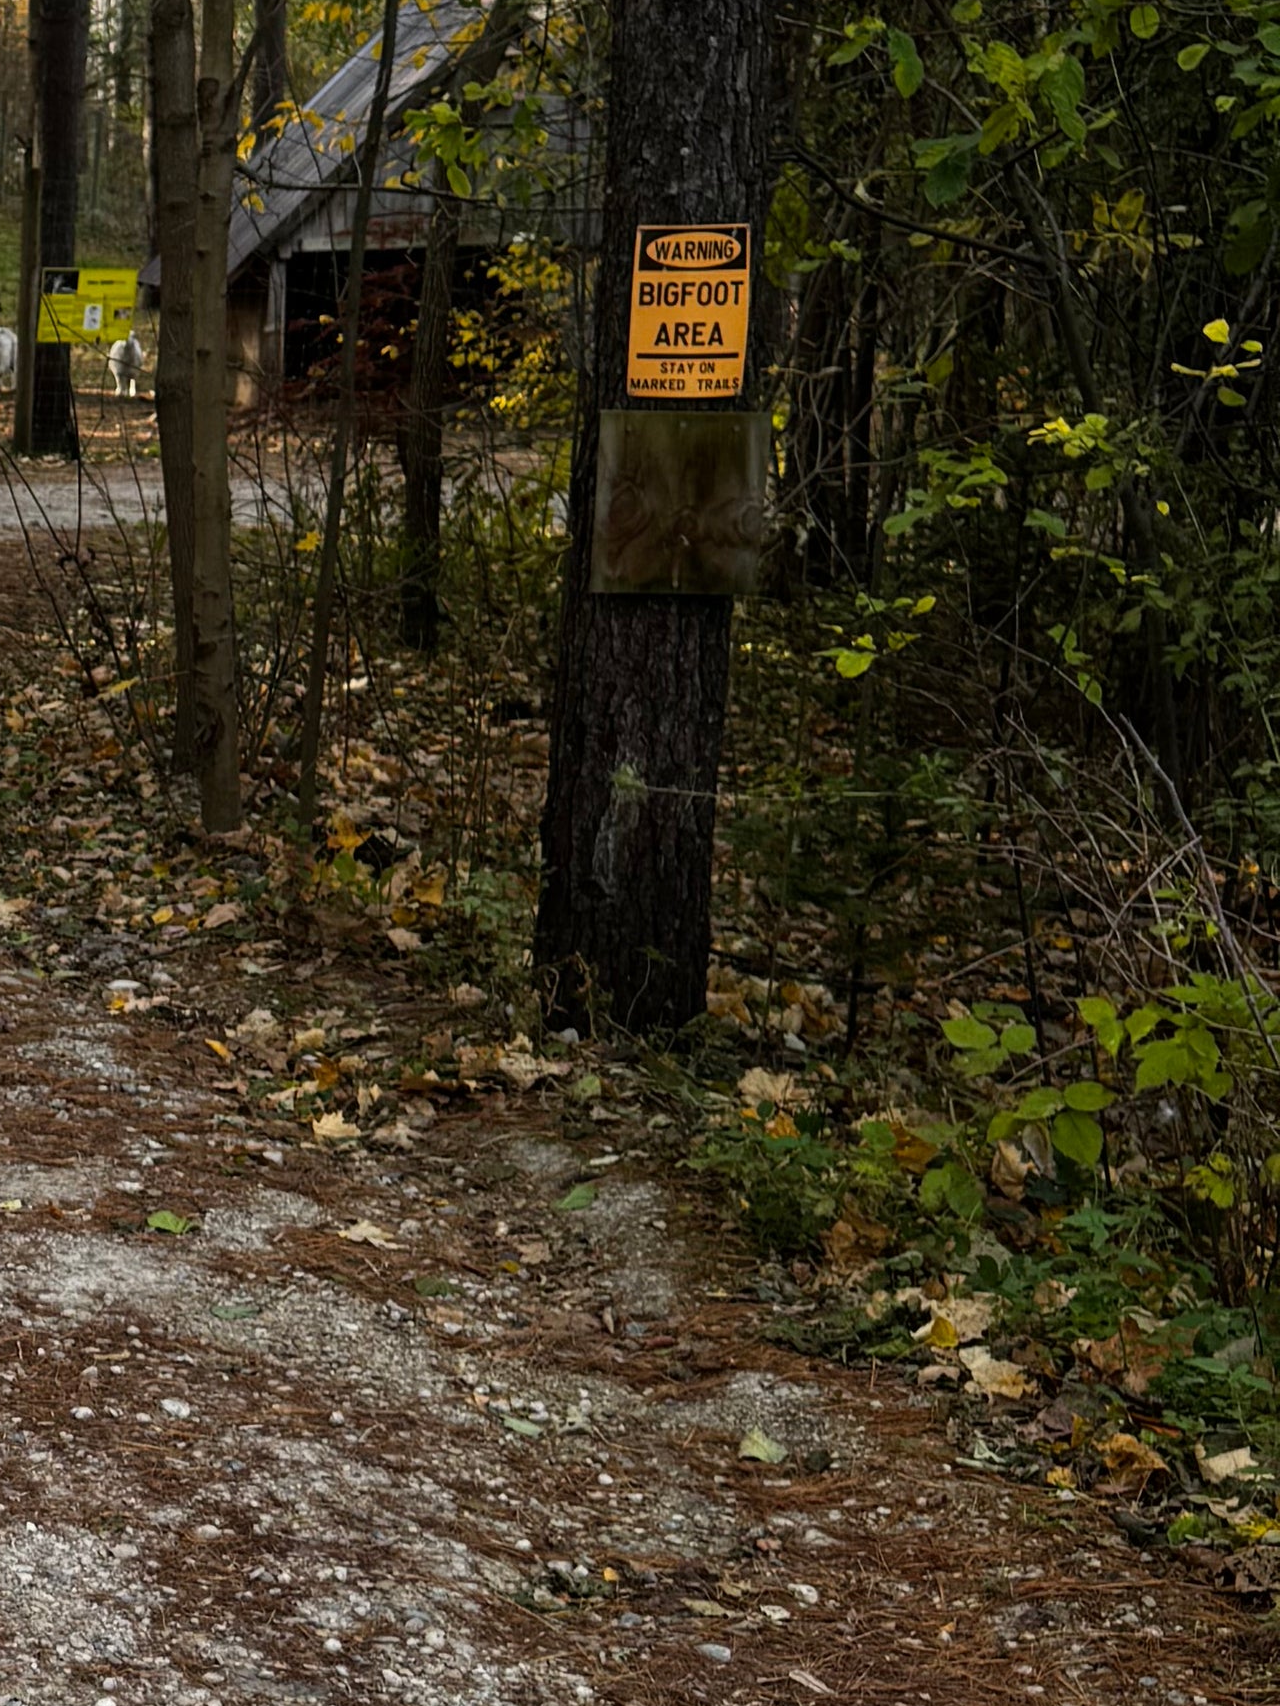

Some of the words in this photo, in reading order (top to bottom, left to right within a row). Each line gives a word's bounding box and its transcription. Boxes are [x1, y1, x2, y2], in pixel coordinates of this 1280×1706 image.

[654, 240, 734, 261] WARNING
[639, 280, 744, 307] BIGFOOT
[654, 321, 724, 346] AREA
[660, 361, 695, 374] STAY
[699, 361, 715, 374] ON
[630, 378, 686, 391] MARKED
[697, 377, 740, 391] TRAILS
